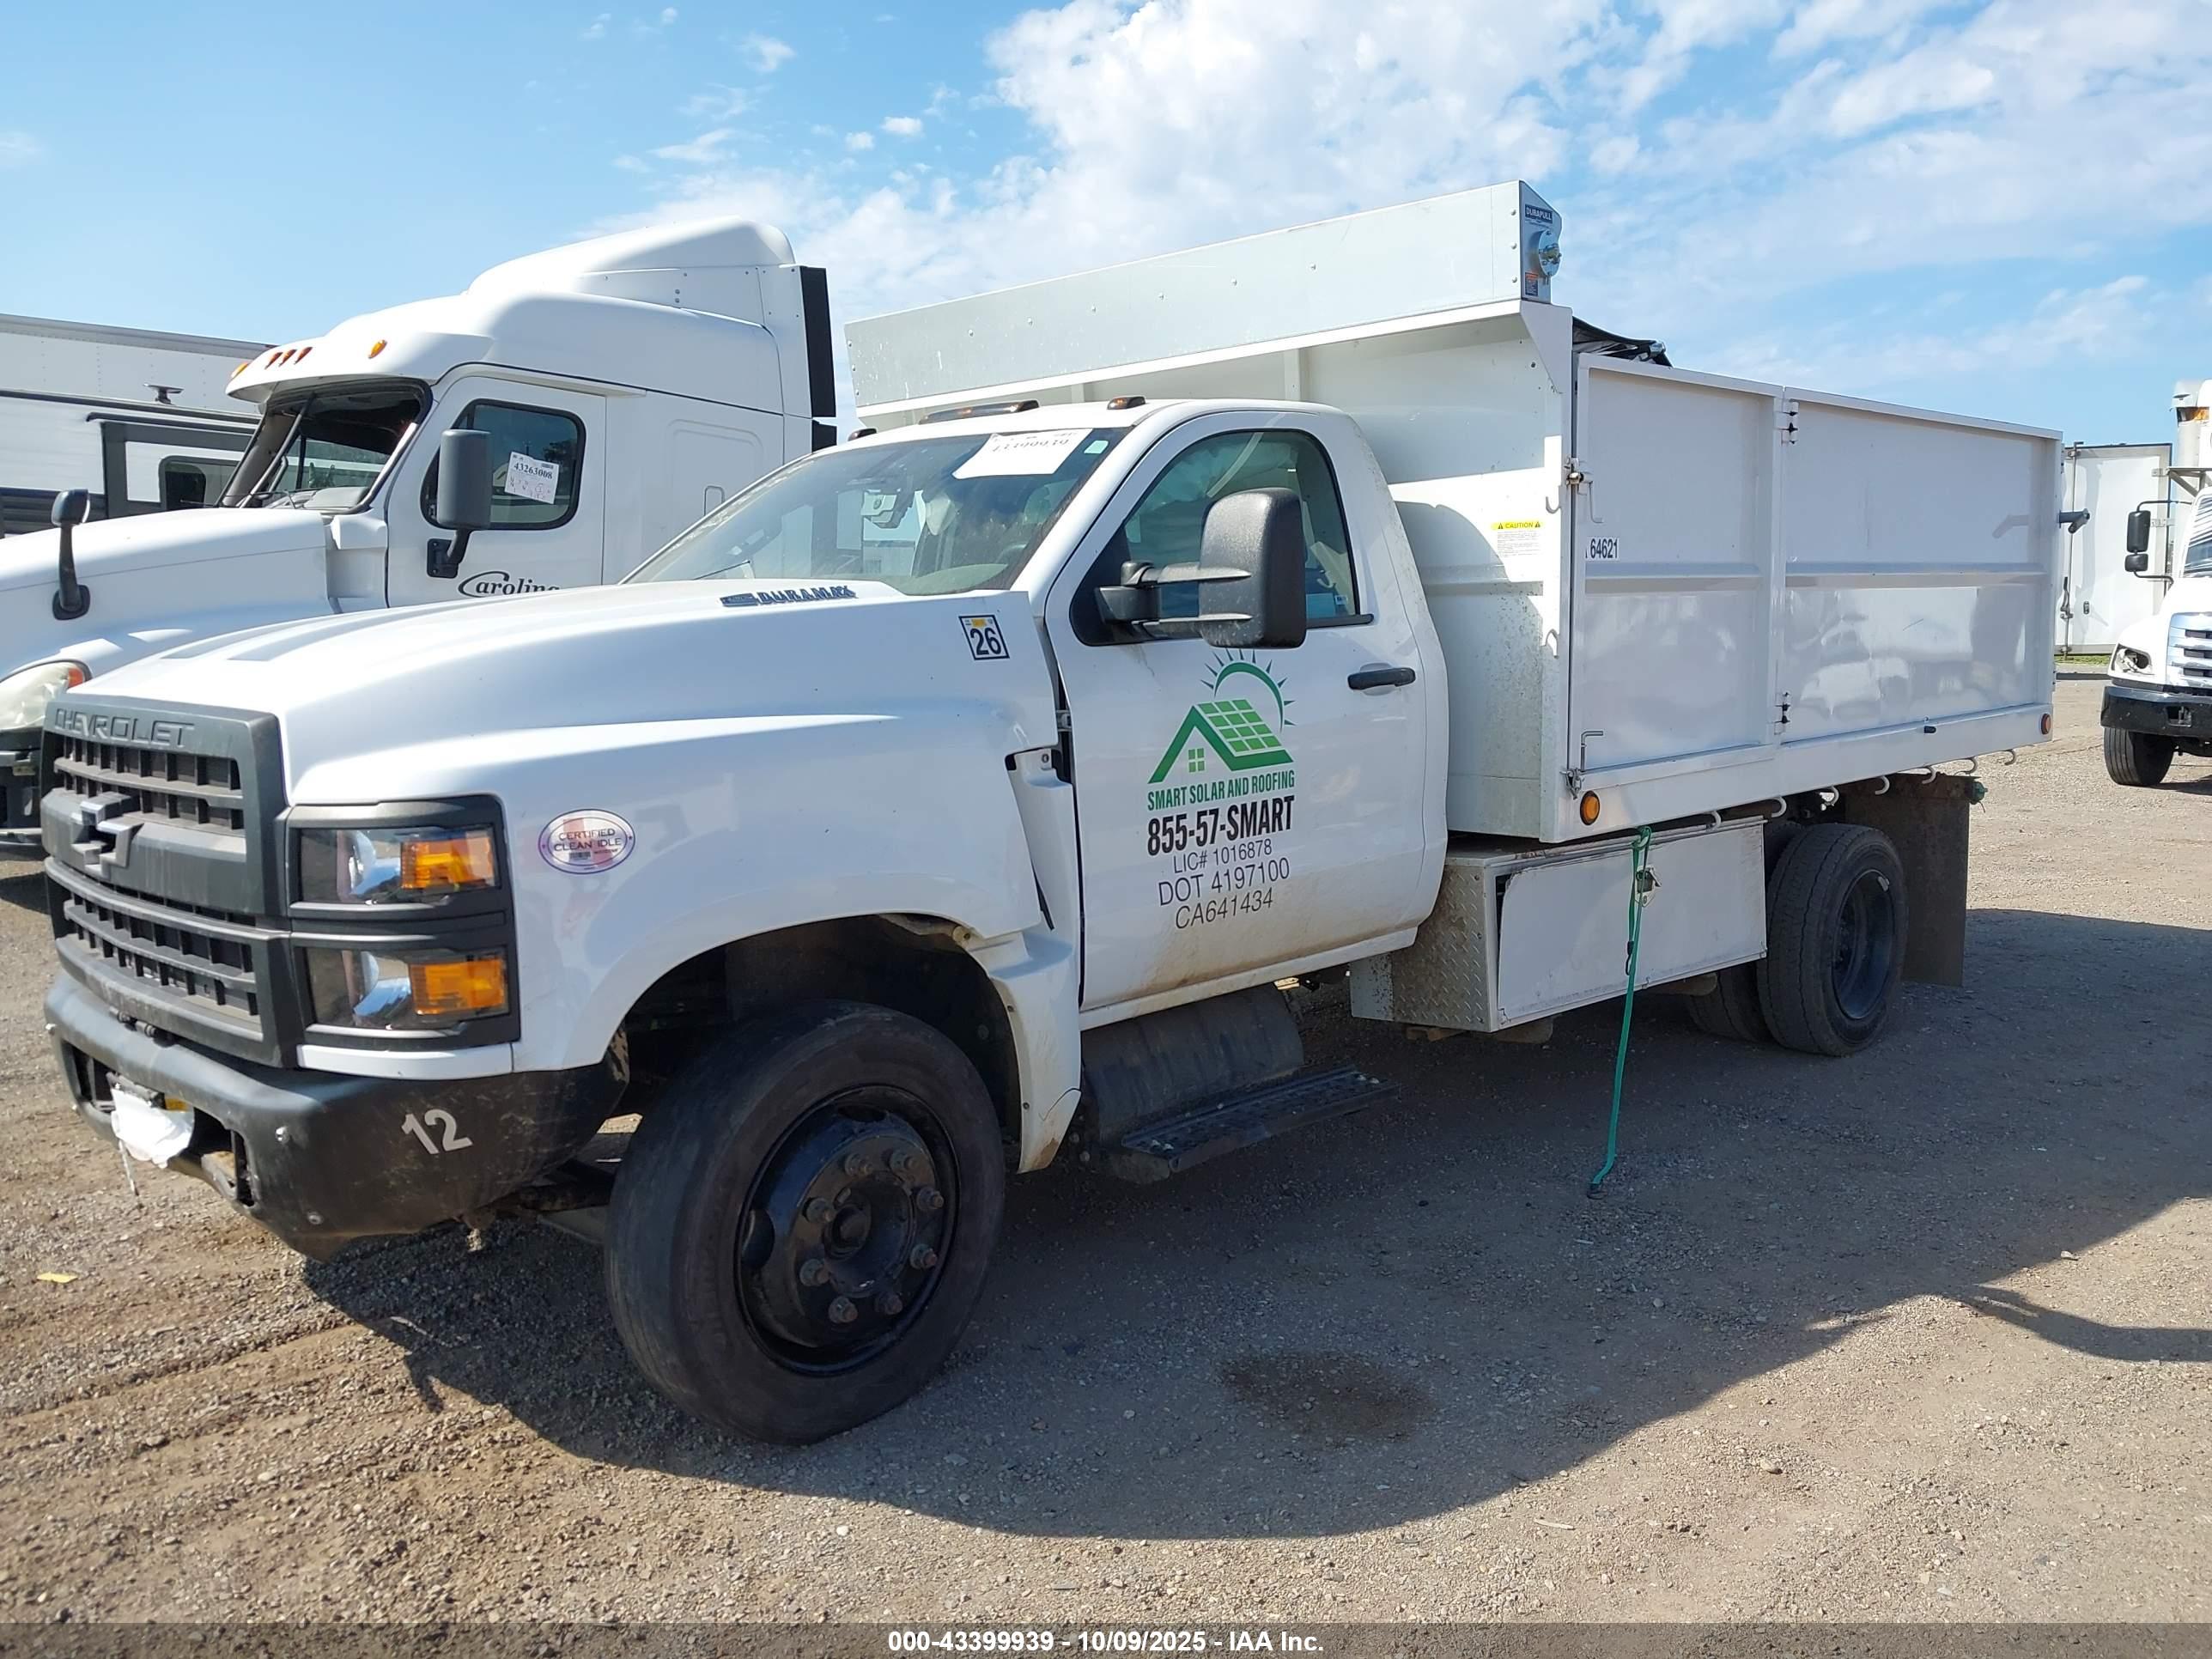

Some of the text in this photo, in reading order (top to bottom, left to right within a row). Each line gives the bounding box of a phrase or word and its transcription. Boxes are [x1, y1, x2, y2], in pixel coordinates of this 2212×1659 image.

[1589, 538, 1619, 559] 64621
[756, 586, 858, 605] DURAMAX
[969, 627, 1002, 655] 26
[54, 708, 196, 748] CHEVROLET
[1147, 769, 1295, 811] SMART SOLAR AND ROOFING
[553, 841, 592, 852] CLEAN
[597, 837, 622, 848] IDLE
[558, 828, 616, 842] CERTIFIED
[1147, 795, 1295, 856] 855-57-SMART
[1173, 838, 1273, 874] LIC# 1016878
[1158, 857, 1290, 906] DOT 4197100
[1175, 887, 1273, 929] CA641434
[401, 1108, 474, 1155] 12
